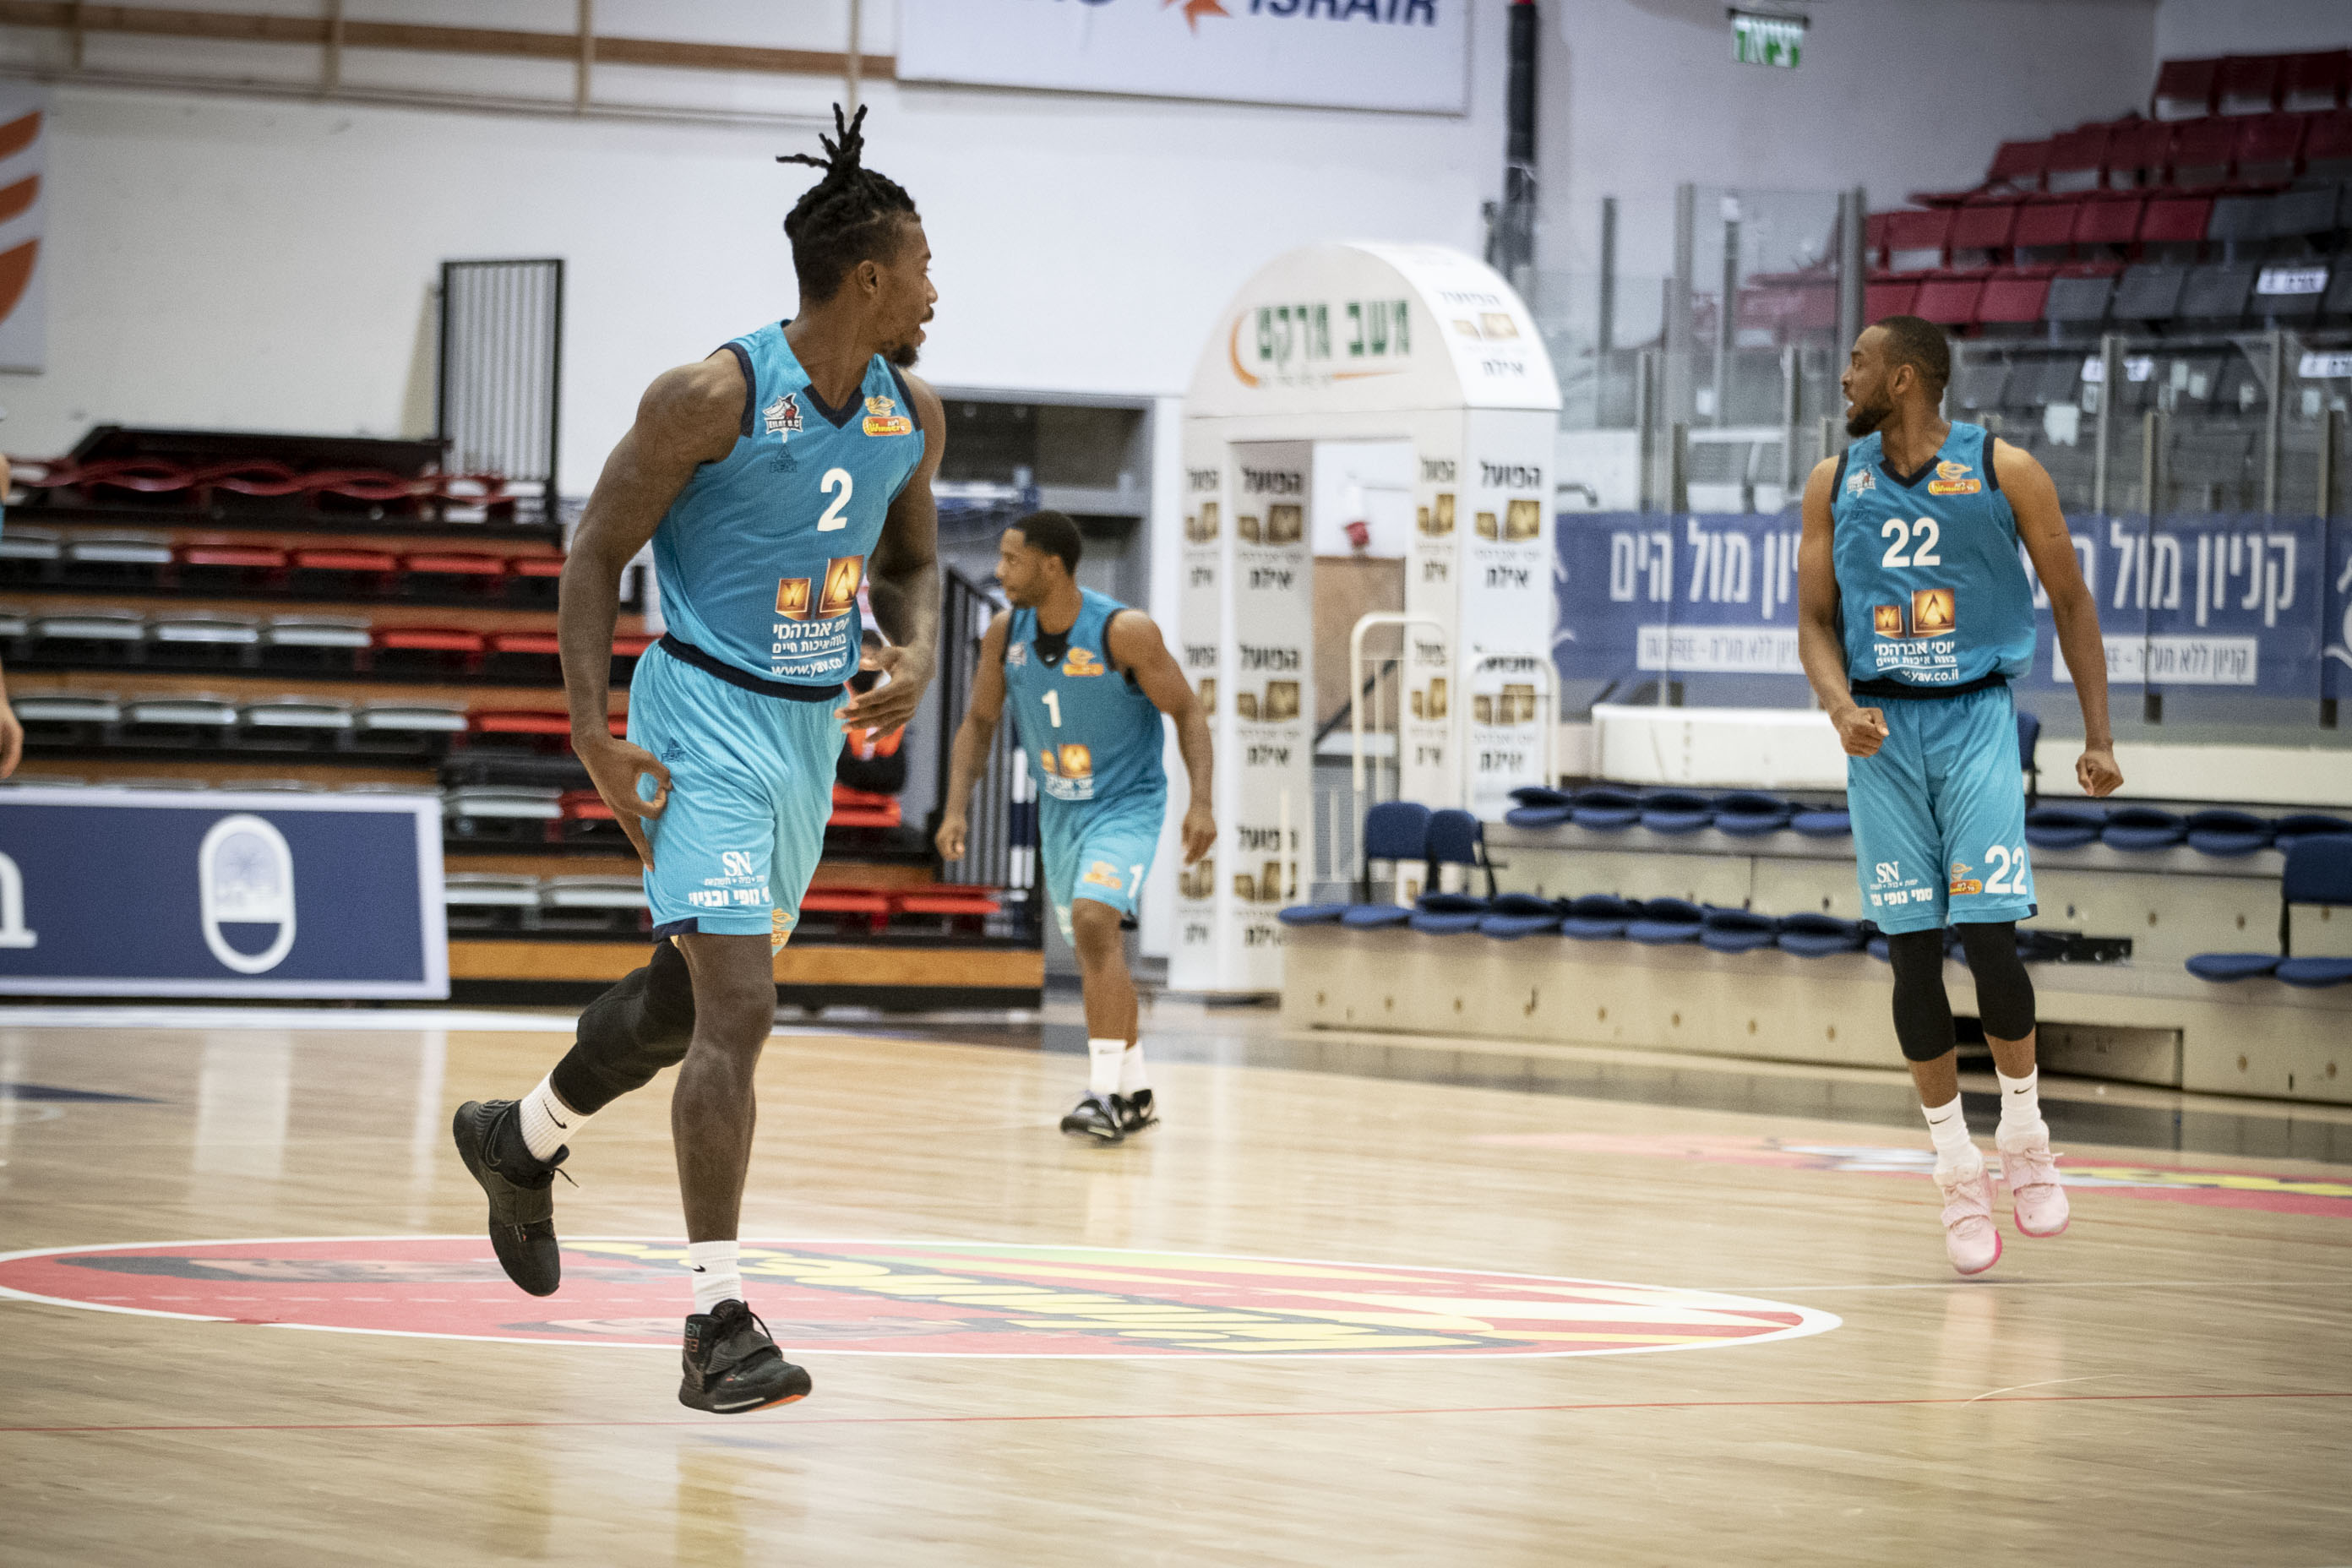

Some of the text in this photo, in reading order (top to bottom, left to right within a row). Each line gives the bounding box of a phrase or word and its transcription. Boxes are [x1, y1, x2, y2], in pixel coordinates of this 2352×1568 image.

[1480, 461, 1540, 487] הפועל
[817, 468, 853, 531] 2
[1687, 518, 1751, 602] מול
[1881, 517, 1941, 568] 22
[1487, 566, 1528, 588] אילת
[1609, 532, 1673, 602] הים
[2110, 520, 2181, 610] מול
[2196, 533, 2296, 628] קניון
[772, 642, 798, 654] חיים
[1239, 645, 1298, 671] הפועל
[1930, 640, 1956, 655] יוסי
[1042, 689, 1062, 728] 1
[722, 851, 753, 877] SN
[1127, 863, 1145, 899] 1
[1876, 861, 1900, 884] SN
[1984, 845, 2027, 895] 22
